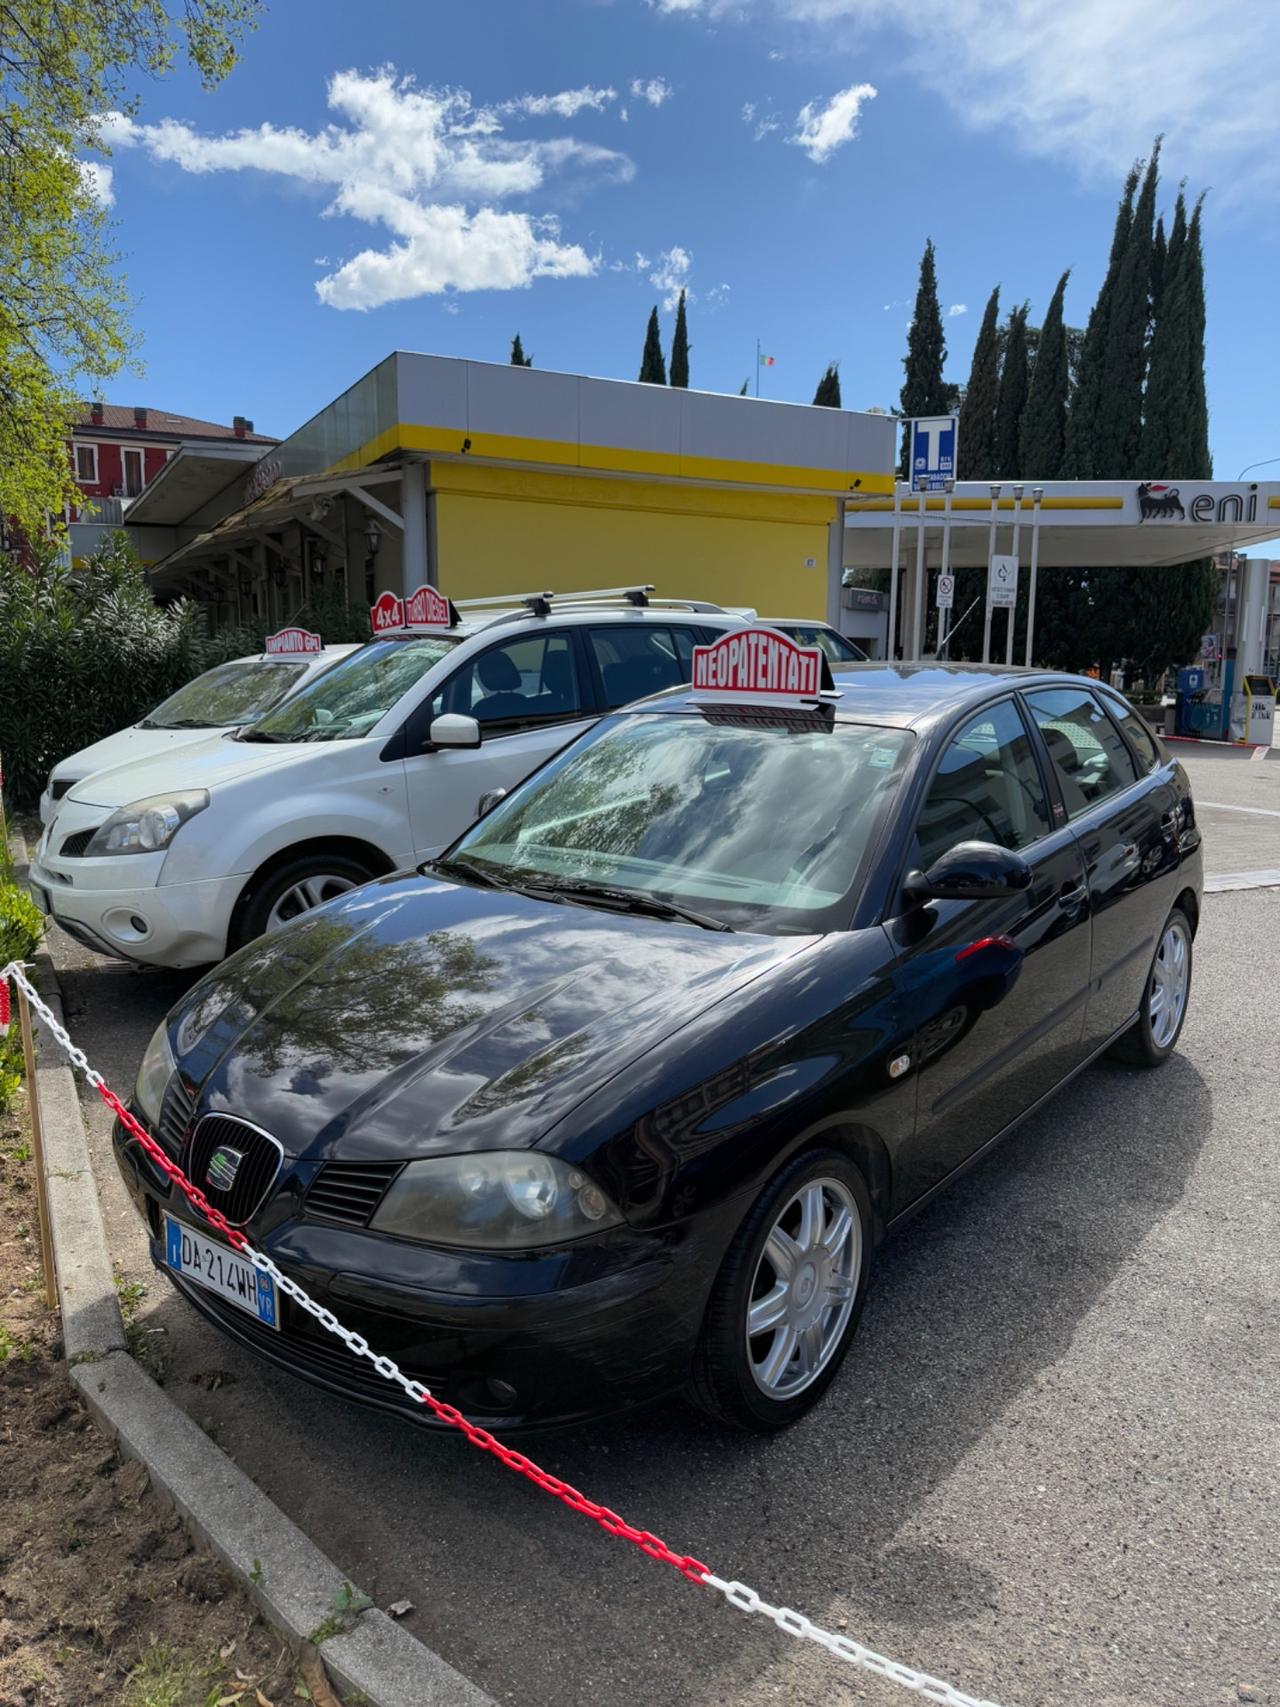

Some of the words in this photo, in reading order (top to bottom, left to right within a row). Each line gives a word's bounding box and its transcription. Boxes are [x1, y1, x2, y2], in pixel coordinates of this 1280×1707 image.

[917, 419, 953, 471] T
[1191, 483, 1258, 522] eni
[376, 602, 400, 628] 4x4
[407, 592, 426, 622] TURBO
[426, 591, 448, 622] DIESEL
[268, 632, 304, 653] IMPIANTO
[305, 634, 319, 651] GPL
[697, 632, 816, 691] NEOPATENTATI
[259, 1293, 273, 1318] VR
